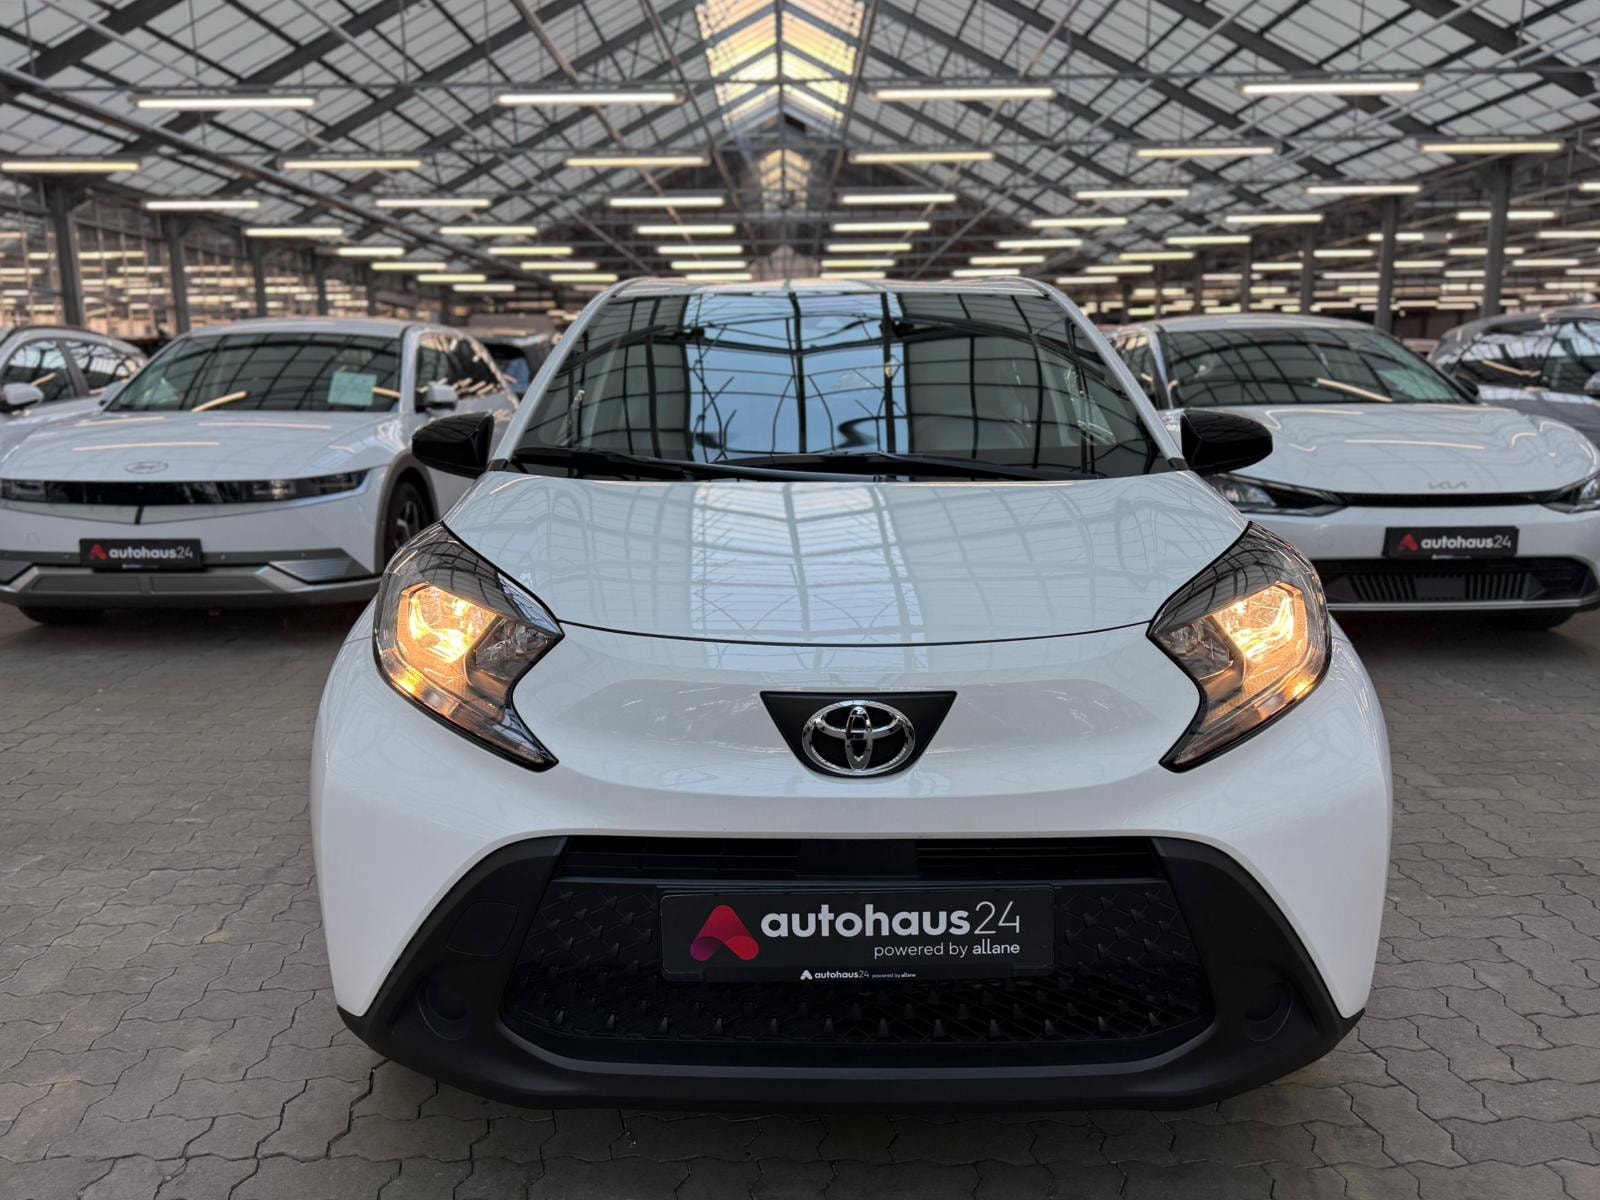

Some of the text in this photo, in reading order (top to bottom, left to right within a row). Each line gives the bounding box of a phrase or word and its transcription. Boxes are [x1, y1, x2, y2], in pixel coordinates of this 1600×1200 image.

[1420, 534, 1512, 549] autohaus24
[108, 546, 193, 559] autohaus24
[760, 901, 1020, 938] autohaus24
[874, 940, 1021, 959] powered by allane
[814, 969, 870, 979] autohaus24
